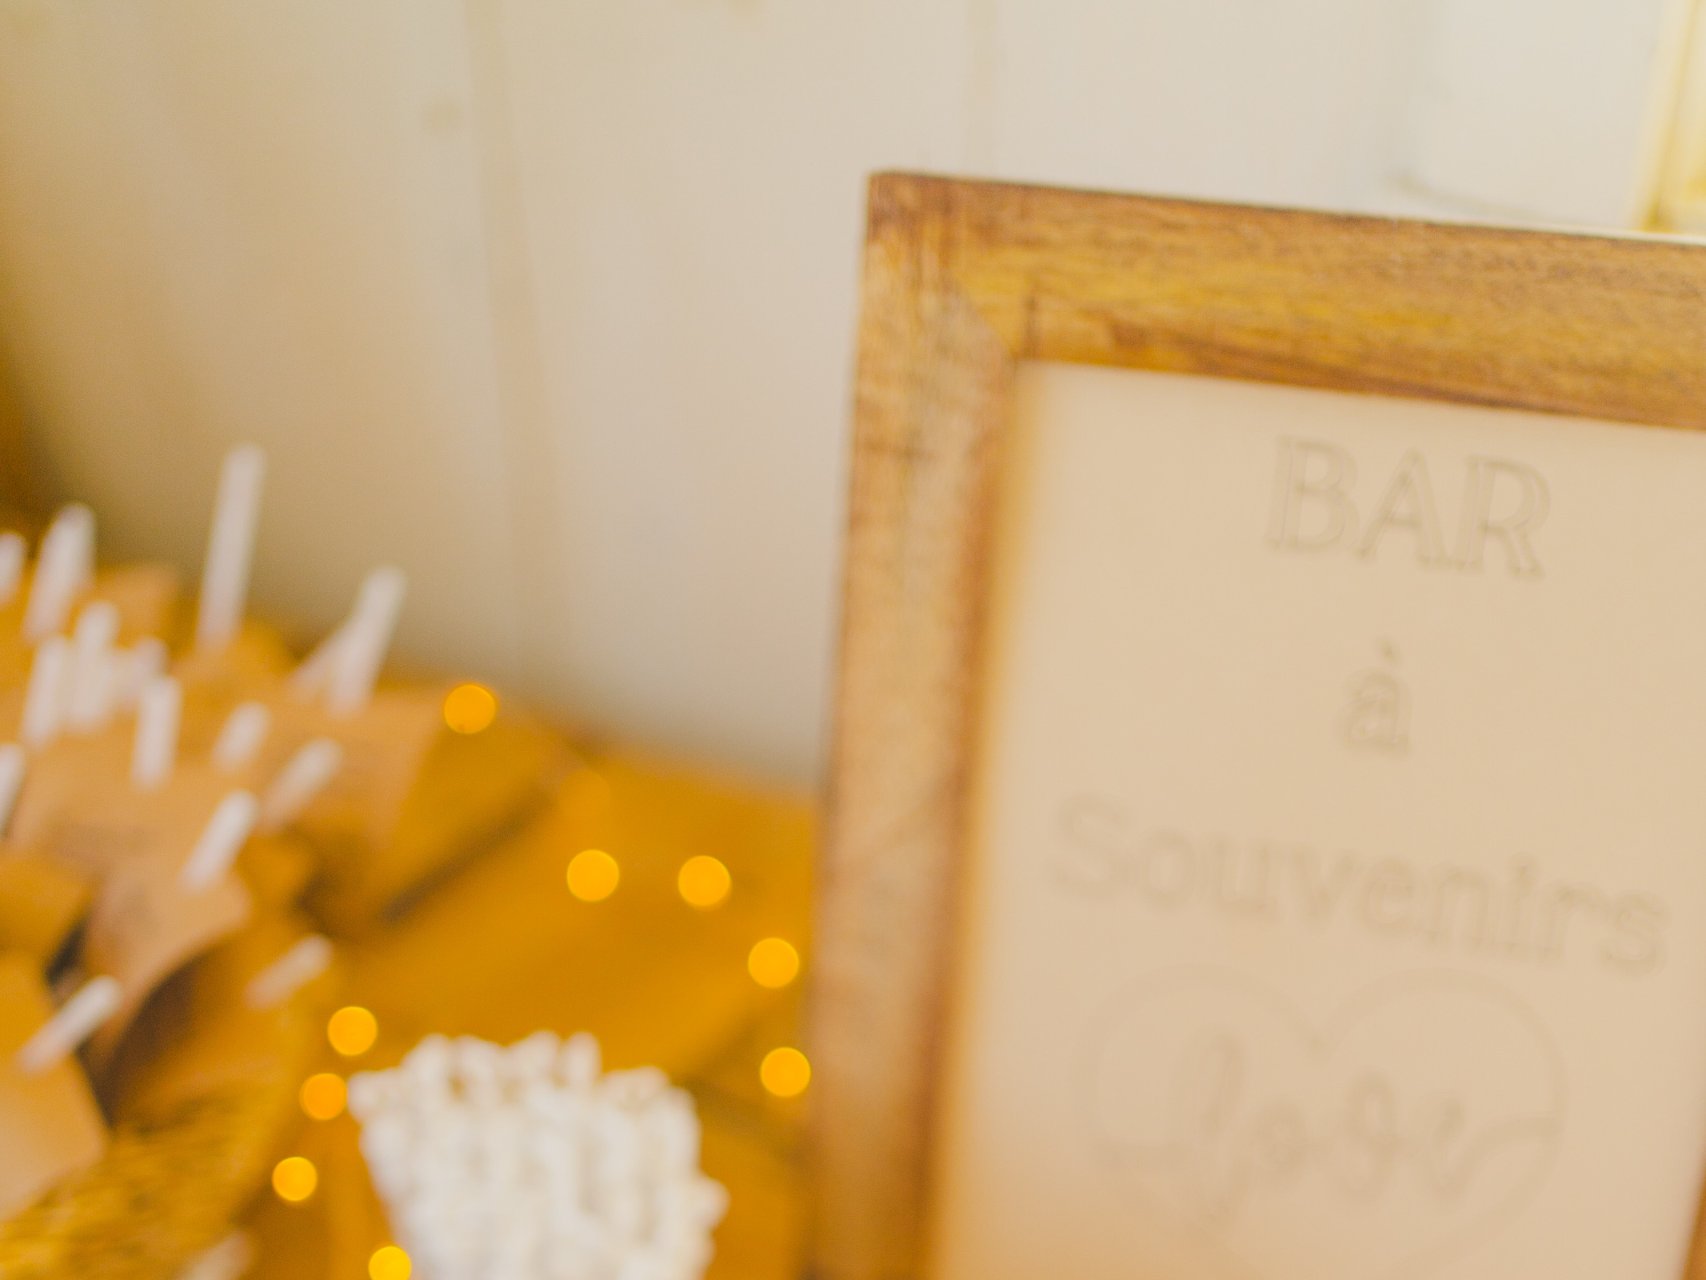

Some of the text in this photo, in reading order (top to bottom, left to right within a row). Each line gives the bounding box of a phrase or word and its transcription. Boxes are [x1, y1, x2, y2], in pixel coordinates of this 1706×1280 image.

[1264, 437, 1551, 580] BAR
[1337, 636, 1412, 757] à
[1048, 793, 1666, 974] Souvenirs
